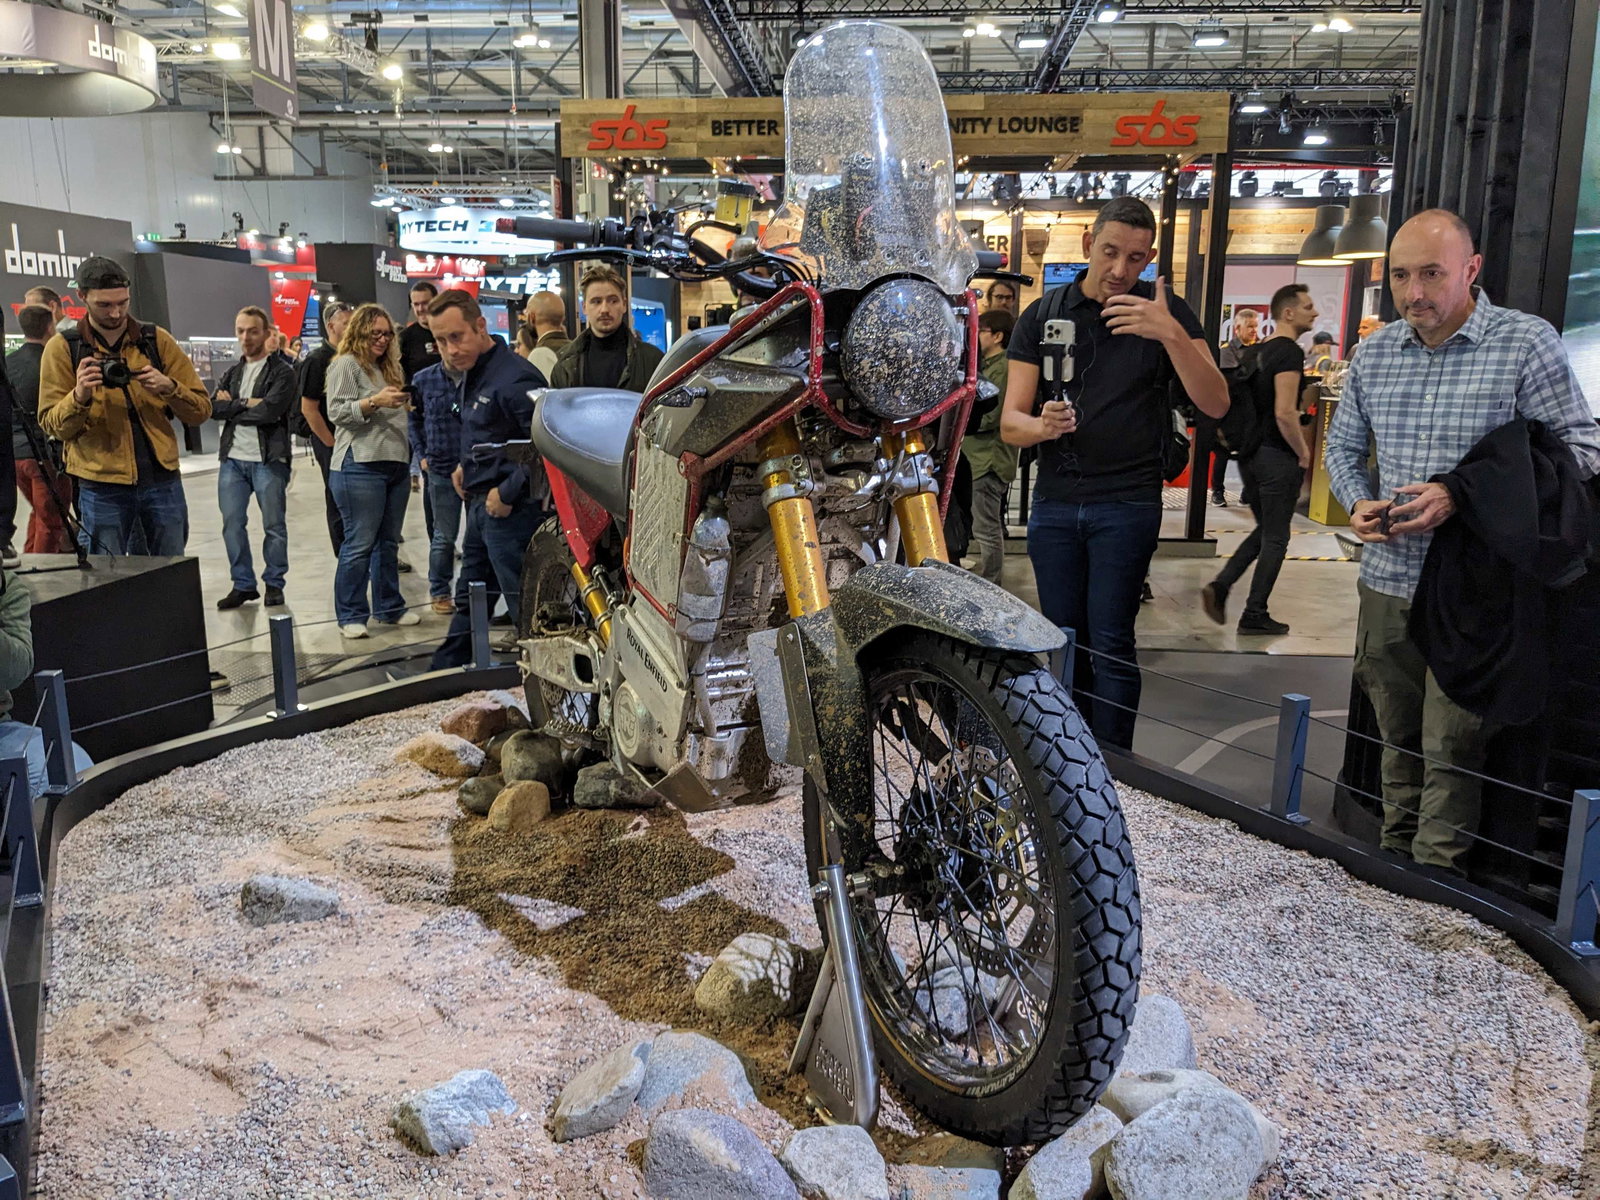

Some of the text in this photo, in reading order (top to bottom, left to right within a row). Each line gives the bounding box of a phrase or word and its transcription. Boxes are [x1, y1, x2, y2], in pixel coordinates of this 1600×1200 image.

[587, 105, 670, 150] sbs
[711, 116, 1080, 137] BETTER NITY LOUNGE
[1110, 100, 1200, 147] sbs
[4, 223, 87, 278] domin
[627, 628, 668, 693] ROYAL ENFIELD
